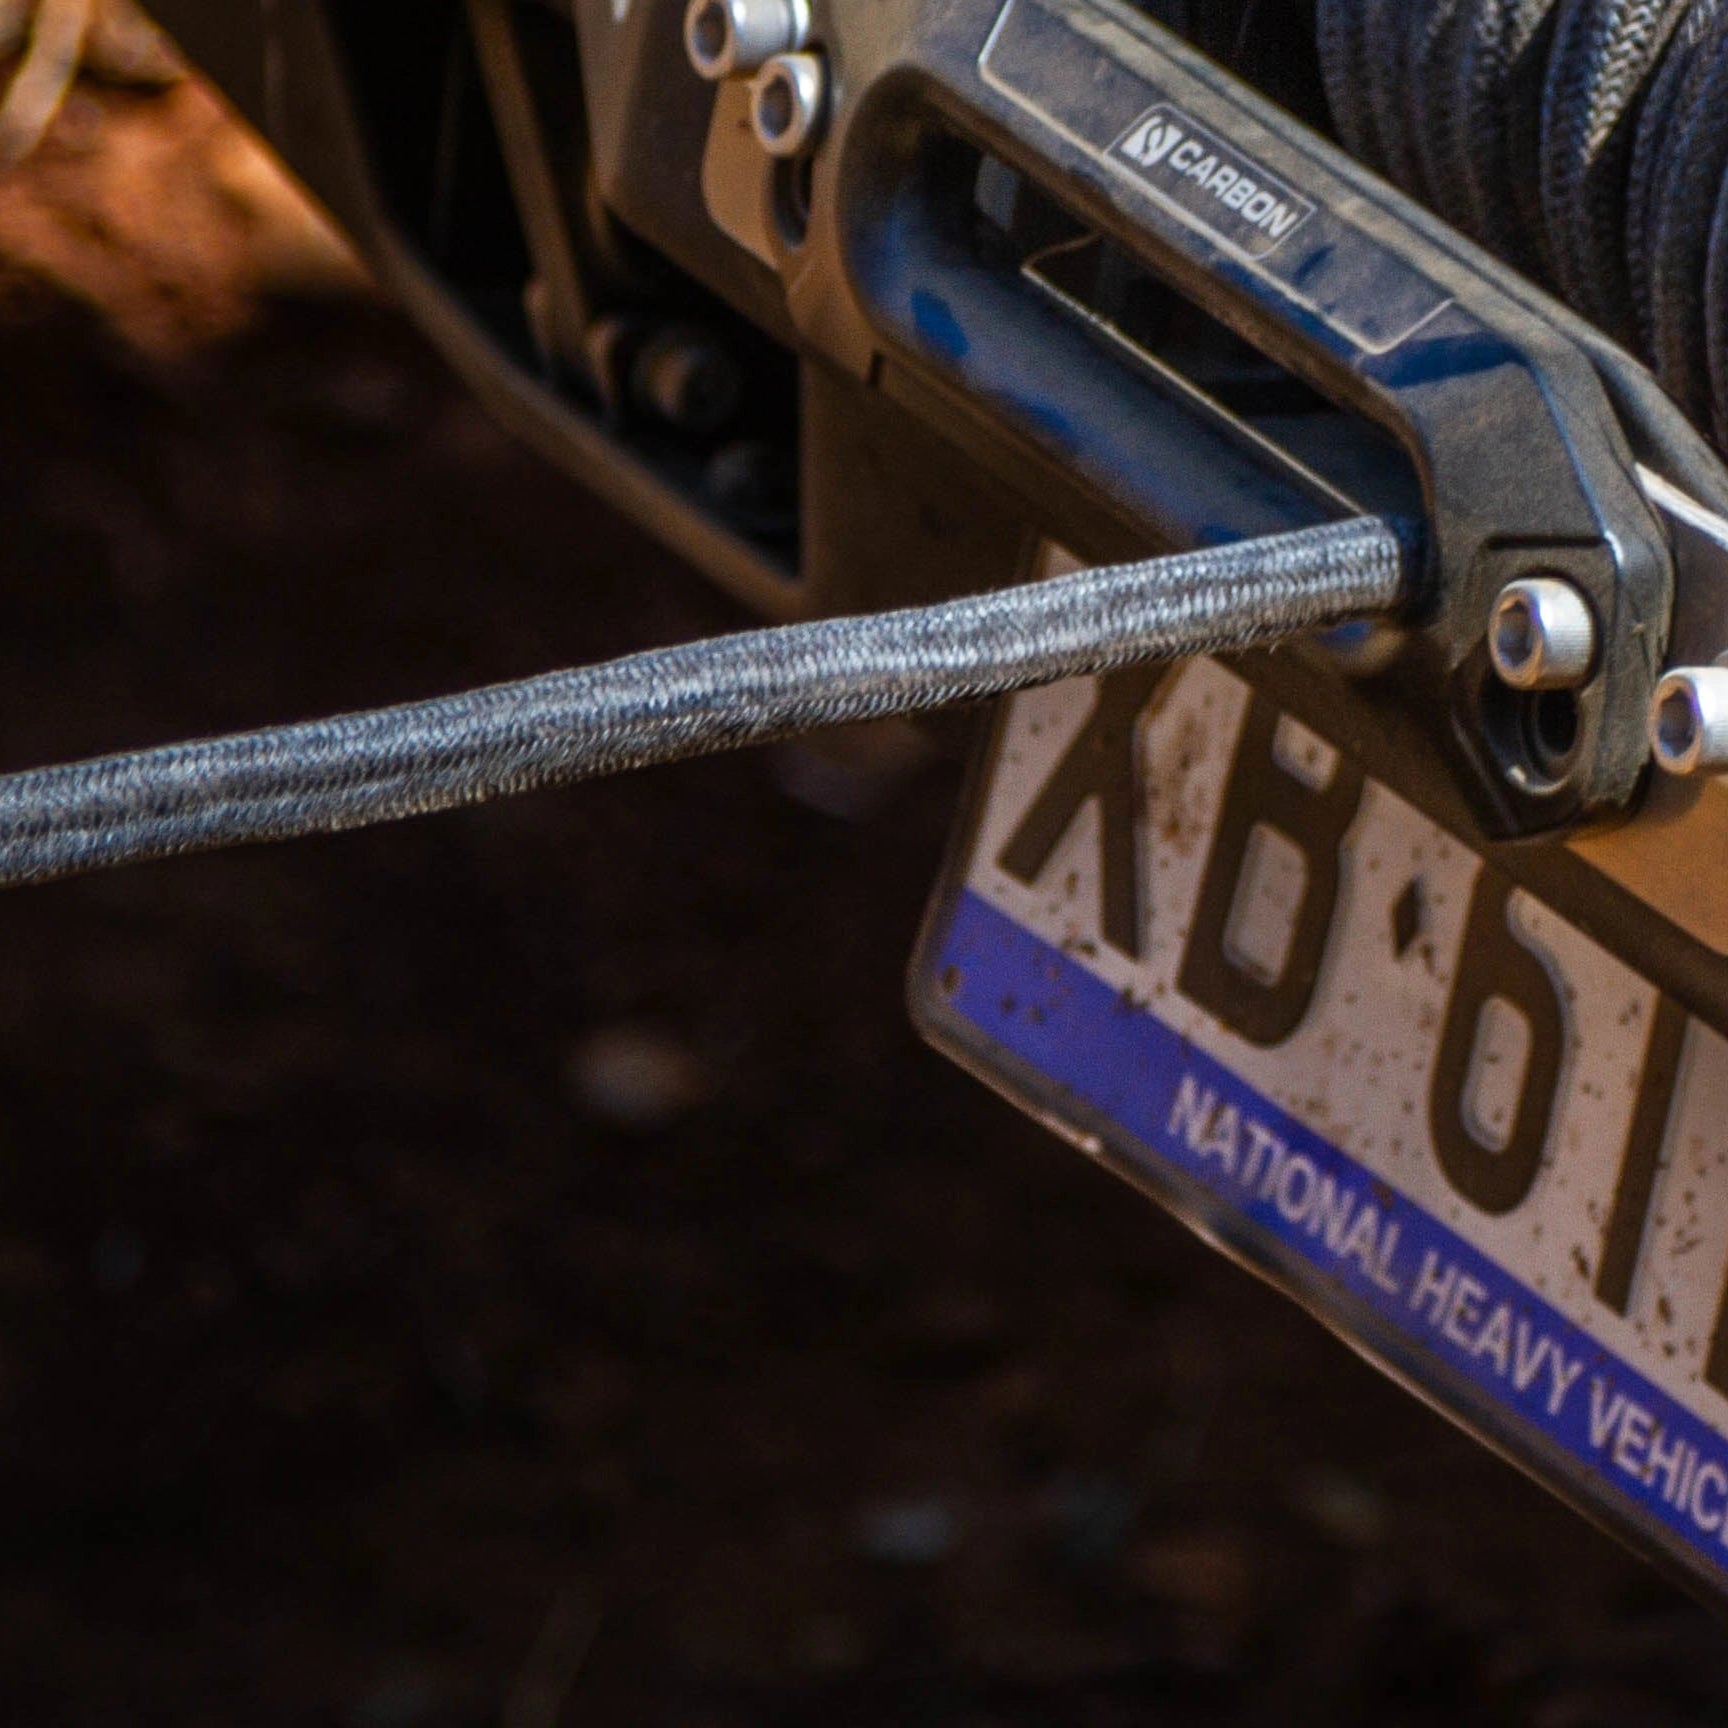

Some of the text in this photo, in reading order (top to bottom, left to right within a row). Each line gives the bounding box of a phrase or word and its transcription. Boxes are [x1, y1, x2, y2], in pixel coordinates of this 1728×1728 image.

[1168, 138, 1298, 238] CARBON
[1166, 1074, 1403, 1293] NATIONAL
[1408, 1249, 1583, 1416] HEAVY
